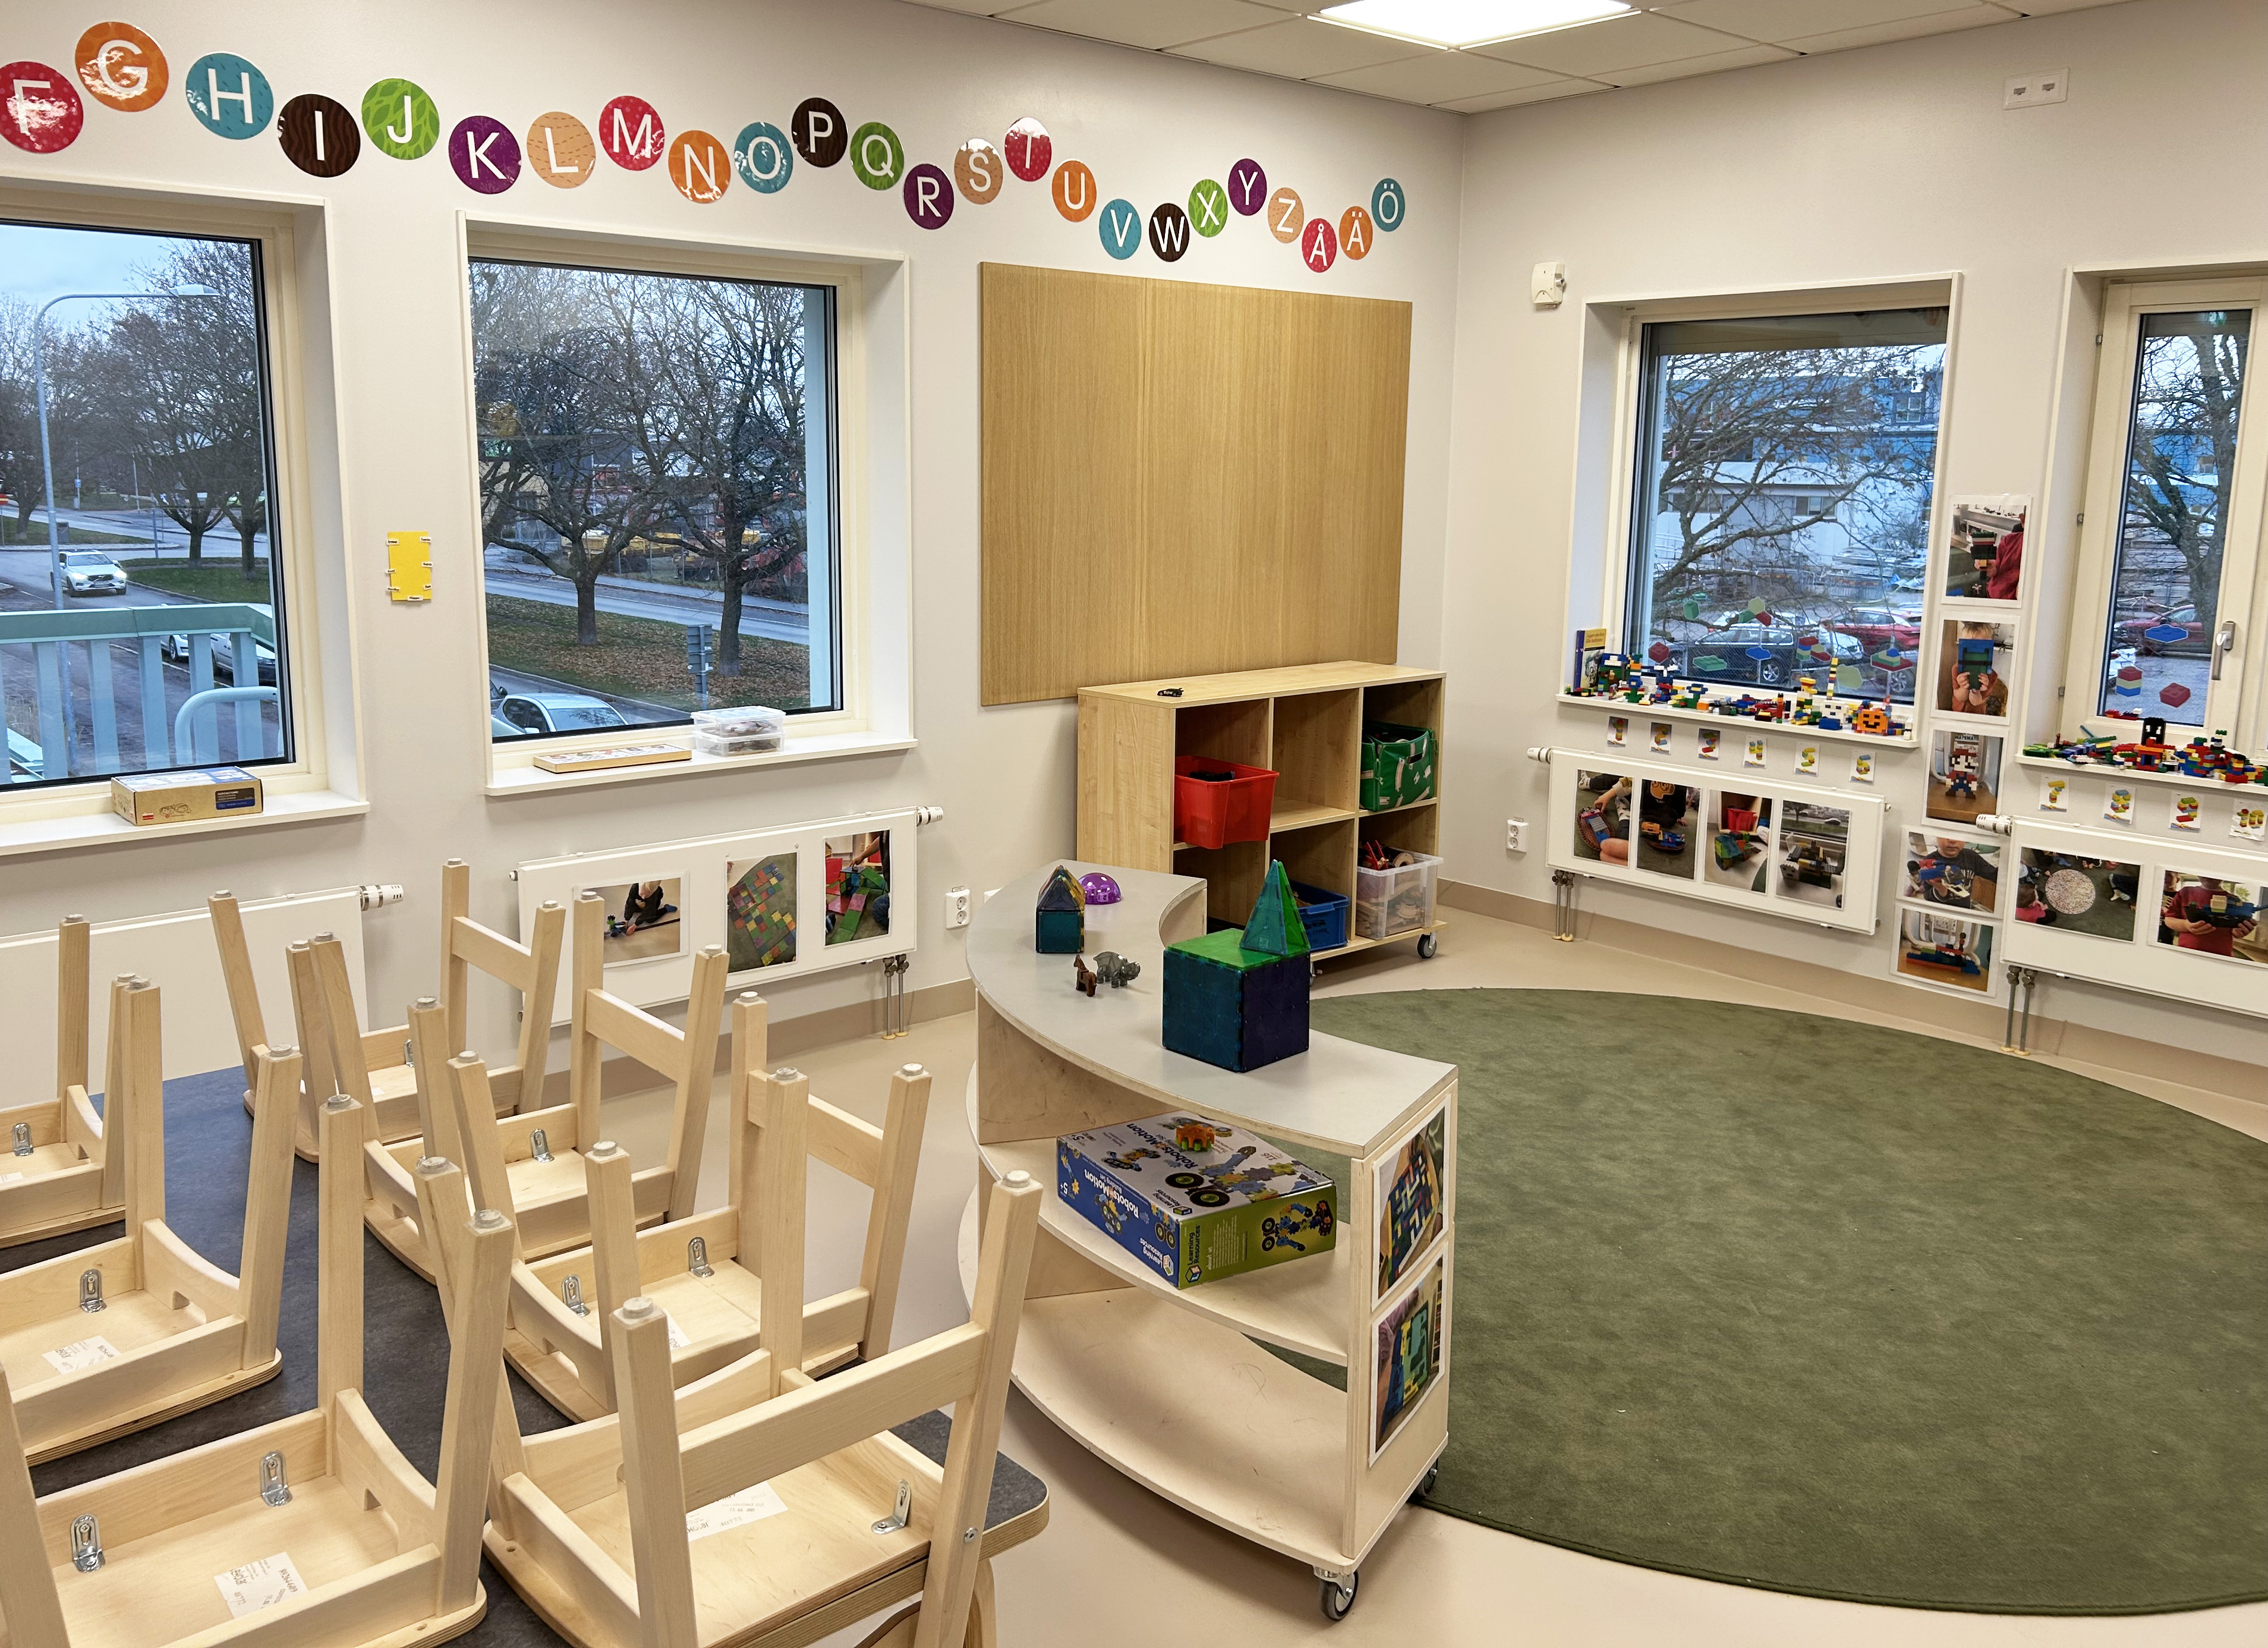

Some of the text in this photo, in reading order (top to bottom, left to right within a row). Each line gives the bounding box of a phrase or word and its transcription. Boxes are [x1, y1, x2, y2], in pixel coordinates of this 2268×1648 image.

[13, 39, 1399, 267] F G H I J K L M N O P Q R S T U V W X Y Z Å Ä Ö
[1127, 1123, 1163, 1145] Motion
[1161, 1146, 1199, 1169] Robots
[1084, 1169, 1110, 1197] Motion
[1113, 1192, 1139, 1219] Robots
[1140, 1237, 1163, 1259] Resources
[1143, 1246, 1163, 1268] Learning
